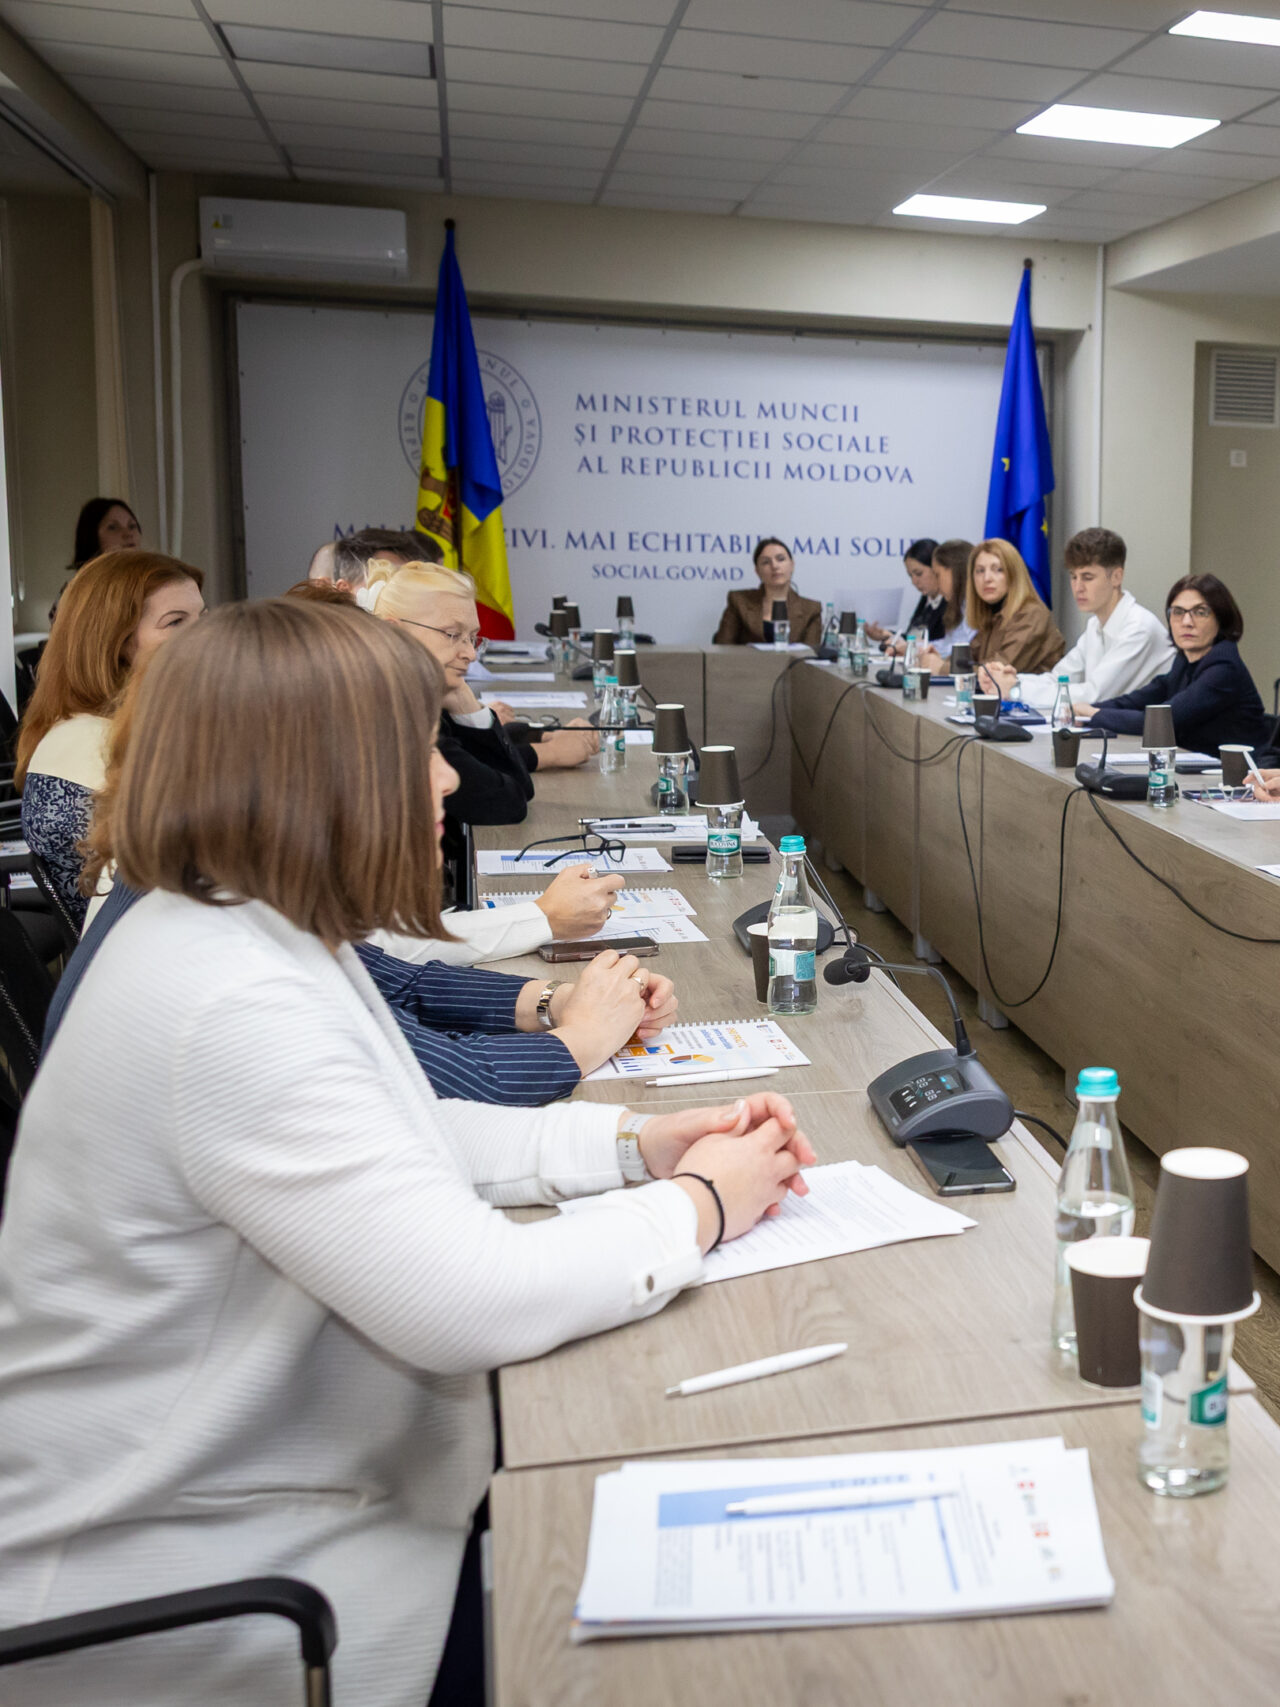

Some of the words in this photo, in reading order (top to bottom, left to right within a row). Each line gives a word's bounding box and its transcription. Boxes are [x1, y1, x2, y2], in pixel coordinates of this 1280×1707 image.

[575, 393, 747, 419] MINISTERUL
[757, 402, 859, 423] MUNCII
[574, 423, 596, 447] ȘI
[611, 424, 770, 451] PROTECȚIEI
[783, 432, 889, 454] SOCIALE
[577, 455, 608, 475] AL
[621, 456, 770, 480] REPUBLICII
[784, 463, 914, 484] MOLDOVA
[564, 530, 616, 551] MAI
[628, 532, 768, 554] ECHITABI
[793, 536, 840, 556] MAI
[850, 537, 916, 557] SOLI
[591, 563, 744, 582] SOCIAL.GOV.MD
